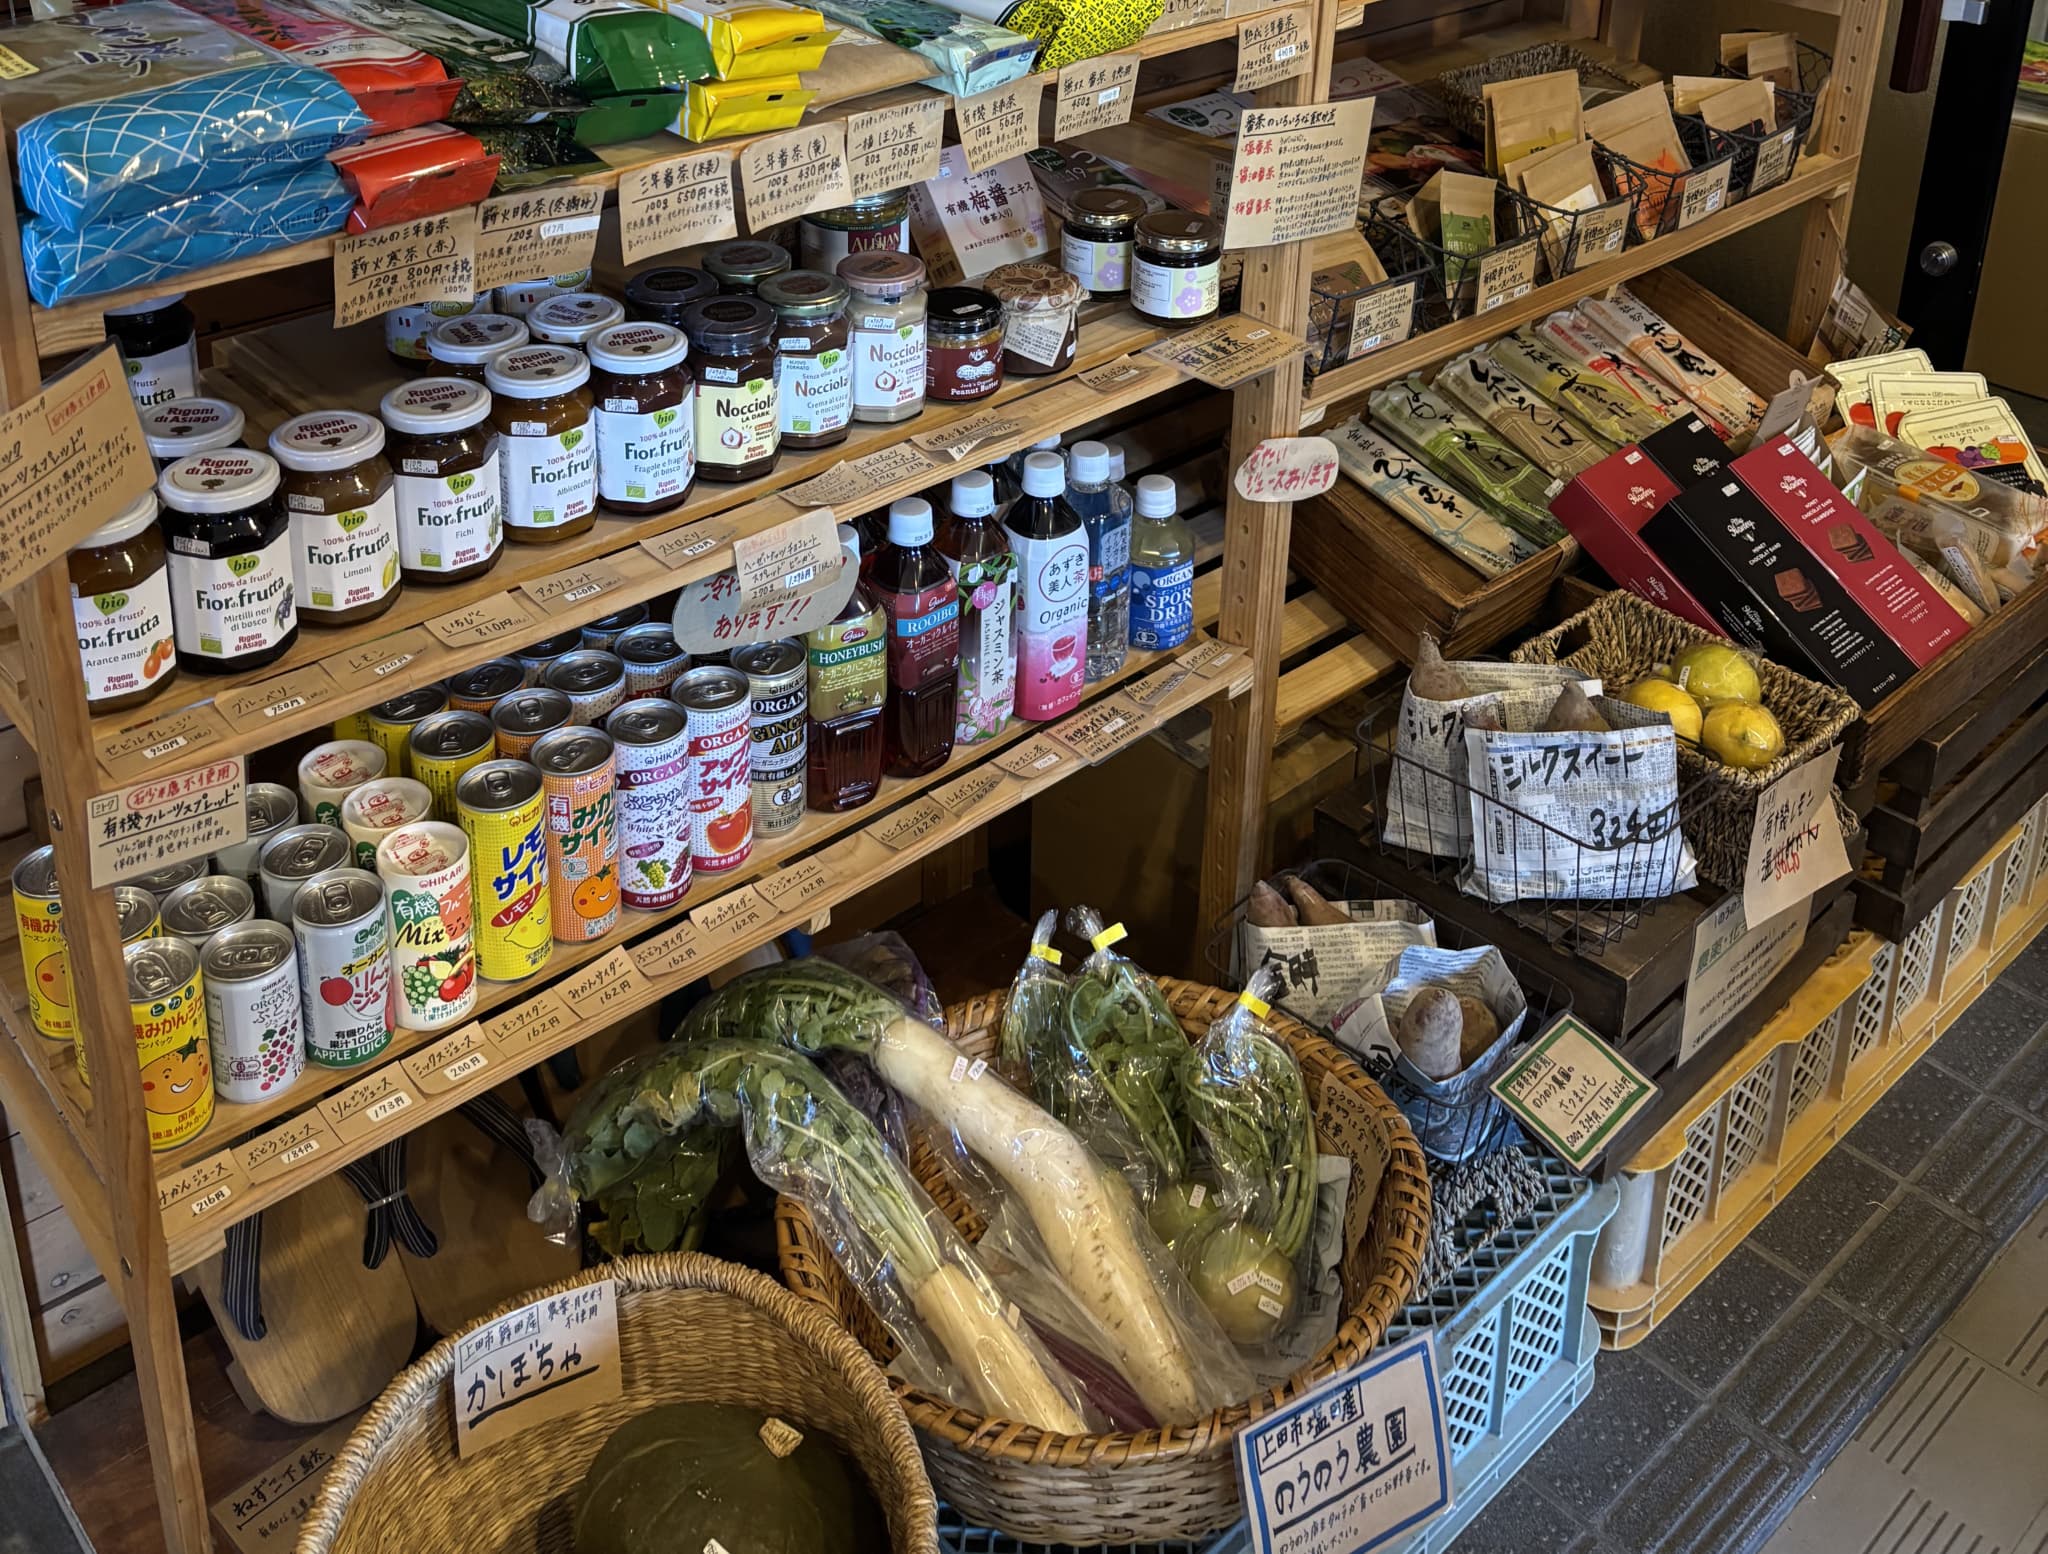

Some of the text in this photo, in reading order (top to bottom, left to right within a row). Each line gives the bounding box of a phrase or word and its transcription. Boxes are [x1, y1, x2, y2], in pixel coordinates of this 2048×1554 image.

[507, 229, 533, 243] 120g
[368, 273, 399, 290] 120g
[869, 342, 924, 363] Nocciola
[951, 387, 980, 397] Peanut
[298, 418, 345, 433] Rigoni
[656, 410, 676, 423] bio
[308, 422, 358, 439] Asiago
[625, 442, 655, 460] Fior
[198, 457, 248, 470] Rigoni
[202, 463, 254, 477] Asiago
[452, 476, 473, 490] bio
[417, 494, 495, 527] Fior frutta
[455, 527, 474, 540] Fichi
[232, 556, 257, 573] bio
[196, 576, 285, 611] Fior frutta
[212, 580, 235, 591] 100%
[535, 572, 592, 597] アプリコット
[1145, 587, 1192, 609] SPOR
[224, 606, 272, 624] Mirtilli neri
[243, 616, 268, 629] bosco
[441, 610, 485, 635] いちじく
[907, 603, 958, 633] ROOIBO
[1039, 596, 1088, 626] Organic
[1150, 600, 1192, 622] DRIN
[238, 632, 263, 644] Rigoni
[243, 638, 268, 650] Asiago
[992, 599, 1006, 687] ジャスミン茶
[86, 654, 120, 668] Arance
[349, 648, 386, 669] レモン
[819, 638, 886, 665] HONEYBUSH
[231, 683, 296, 715] ブルーベリー
[1407, 707, 1465, 748] ミルク
[769, 731, 805, 756] ALE
[1501, 740, 1644, 791] ミルクスイート
[551, 797, 569, 832] 有機
[428, 864, 465, 889] HIKARI
[1776, 851, 1801, 882] SOLD
[800, 877, 825, 898] 162円
[396, 897, 439, 920] 有機
[499, 889, 538, 924] レモン
[731, 912, 760, 934] 162円
[395, 924, 444, 949] Mix
[637, 929, 692, 965] ぶどうサイダー
[668, 947, 697, 970] 162円
[568, 956, 624, 1000] みかんサイダー
[600, 980, 631, 1005] 162円
[493, 999, 549, 1039] レモンサイダー
[527, 1016, 561, 1041] 162円
[314, 1034, 389, 1061] APPLE JUICE
[413, 1035, 476, 1077] ミックスジュース
[450, 1056, 481, 1077] 200円
[331, 1077, 392, 1120] りんごジュース
[373, 1097, 406, 1119] 173円
[248, 1123, 316, 1167] ぶどうジュース
[197, 1191, 226, 1213] 216円
[565, 1304, 598, 1329] 不使用
[467, 1338, 582, 1414] かぼちゃ
[1275, 1407, 1407, 1516] のうのう農園
